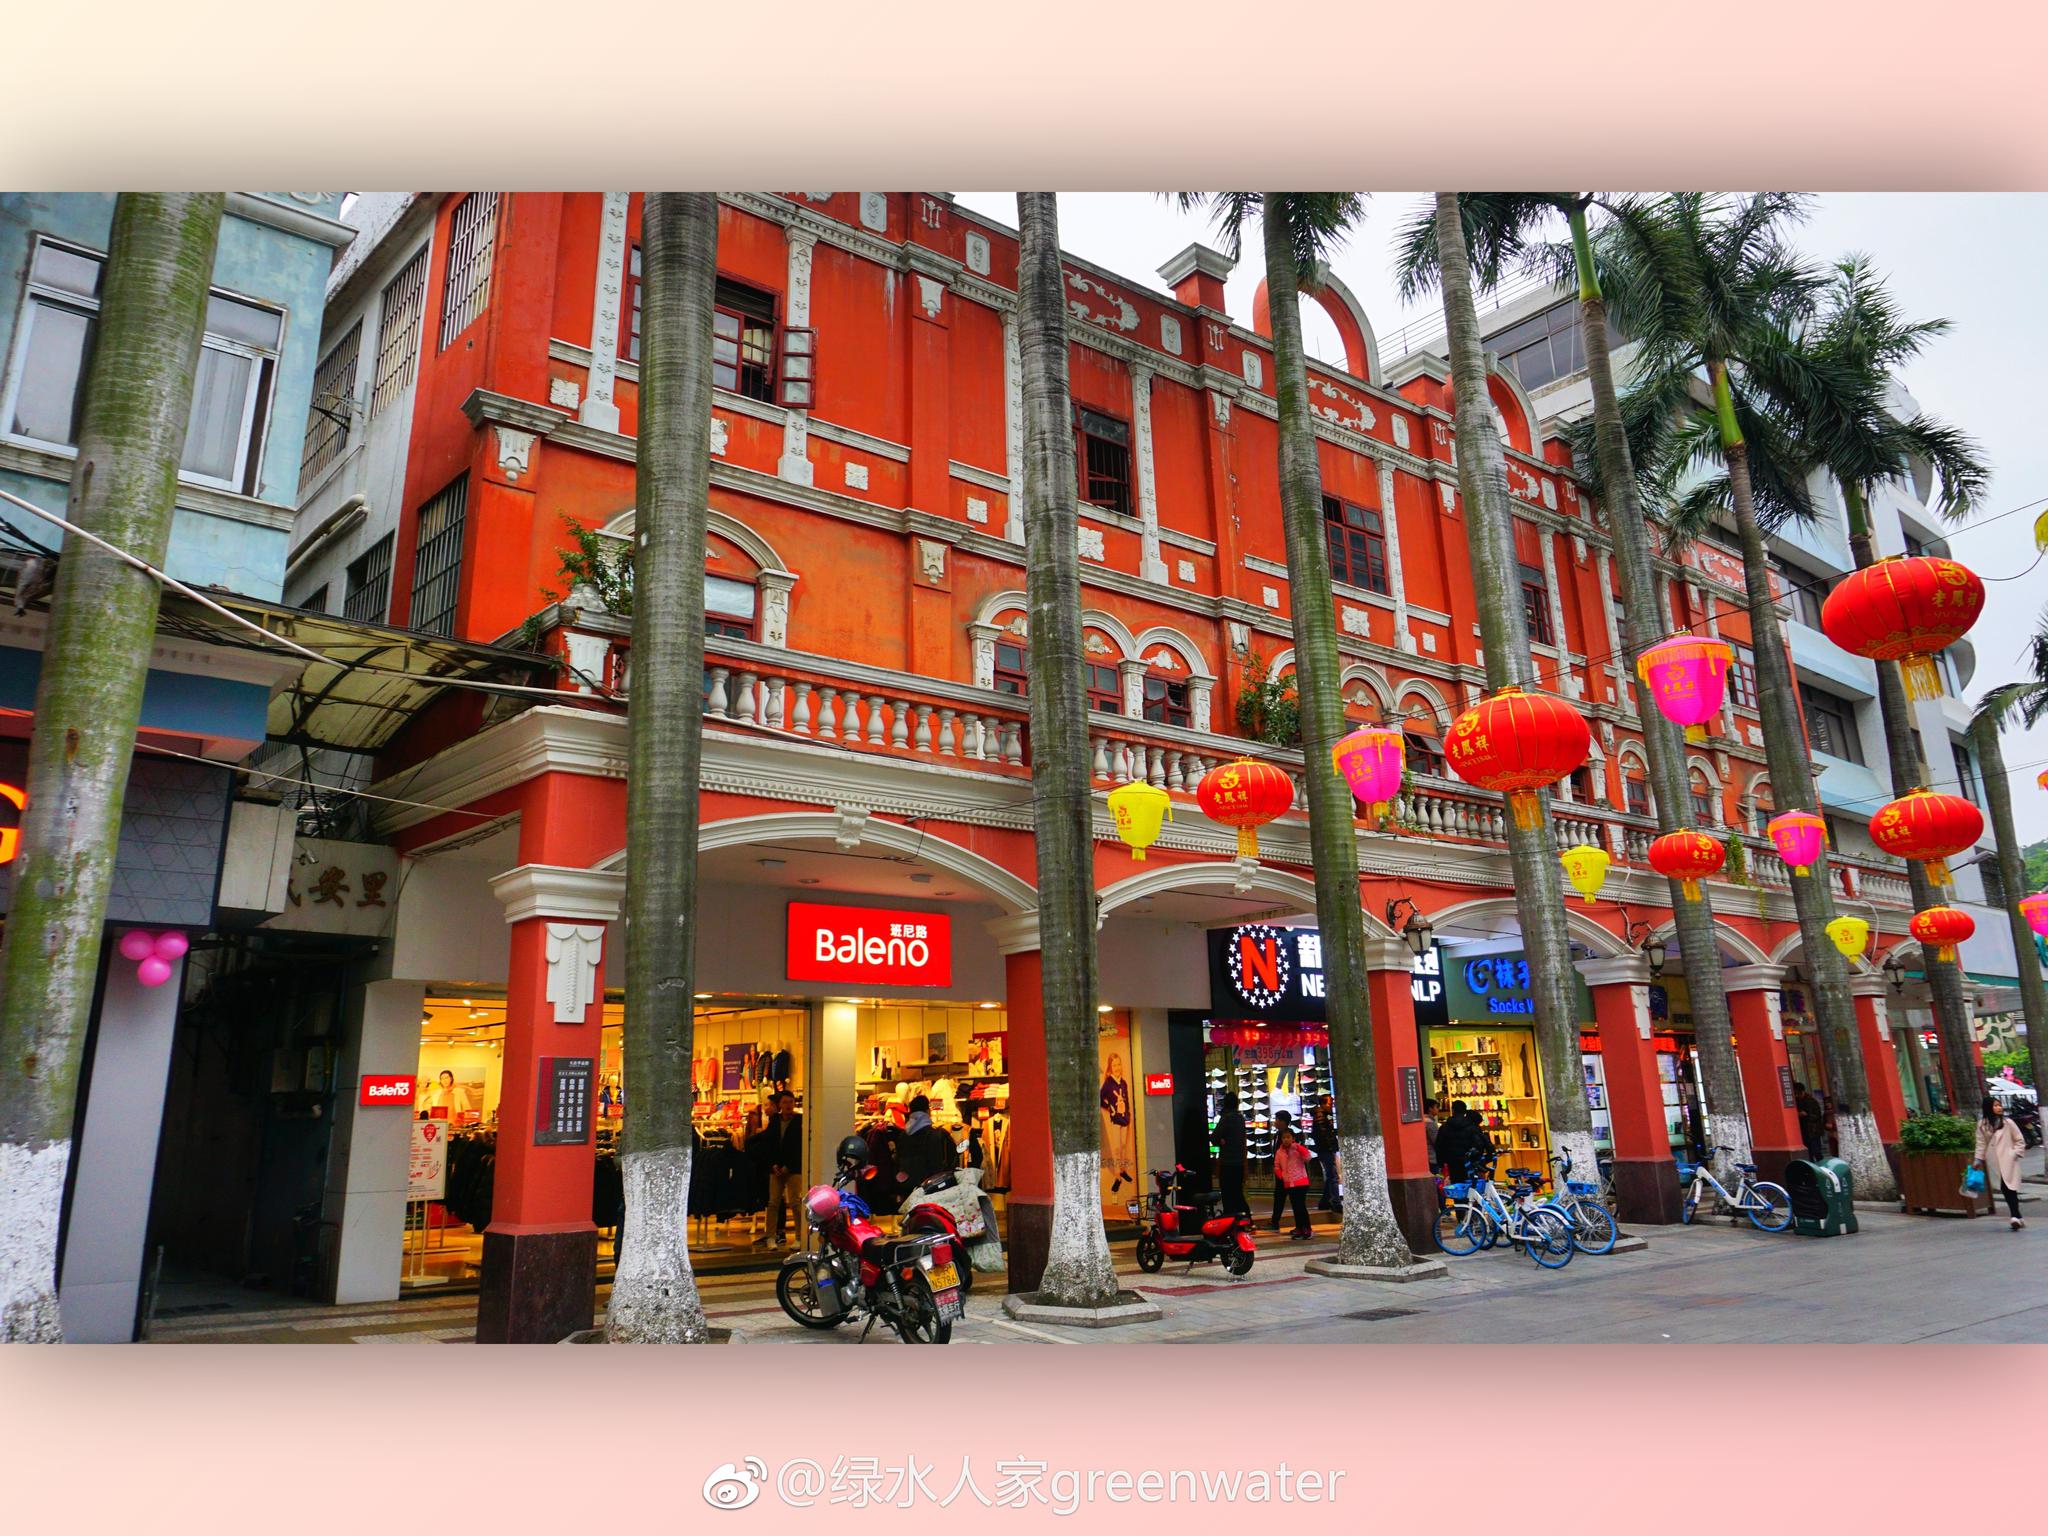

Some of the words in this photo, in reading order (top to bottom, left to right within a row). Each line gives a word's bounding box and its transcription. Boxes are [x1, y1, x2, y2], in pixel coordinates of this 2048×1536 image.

[1452, 735, 1490, 759] 老鳳祥
[1213, 790, 1248, 805] 老鳳祥
[890, 923, 928, 939] 班尼路
[815, 927, 930, 968] Baleno
[1240, 935, 1280, 991] N
[1489, 996, 1526, 1015] Socks
[368, 1084, 410, 1096] Baleno
